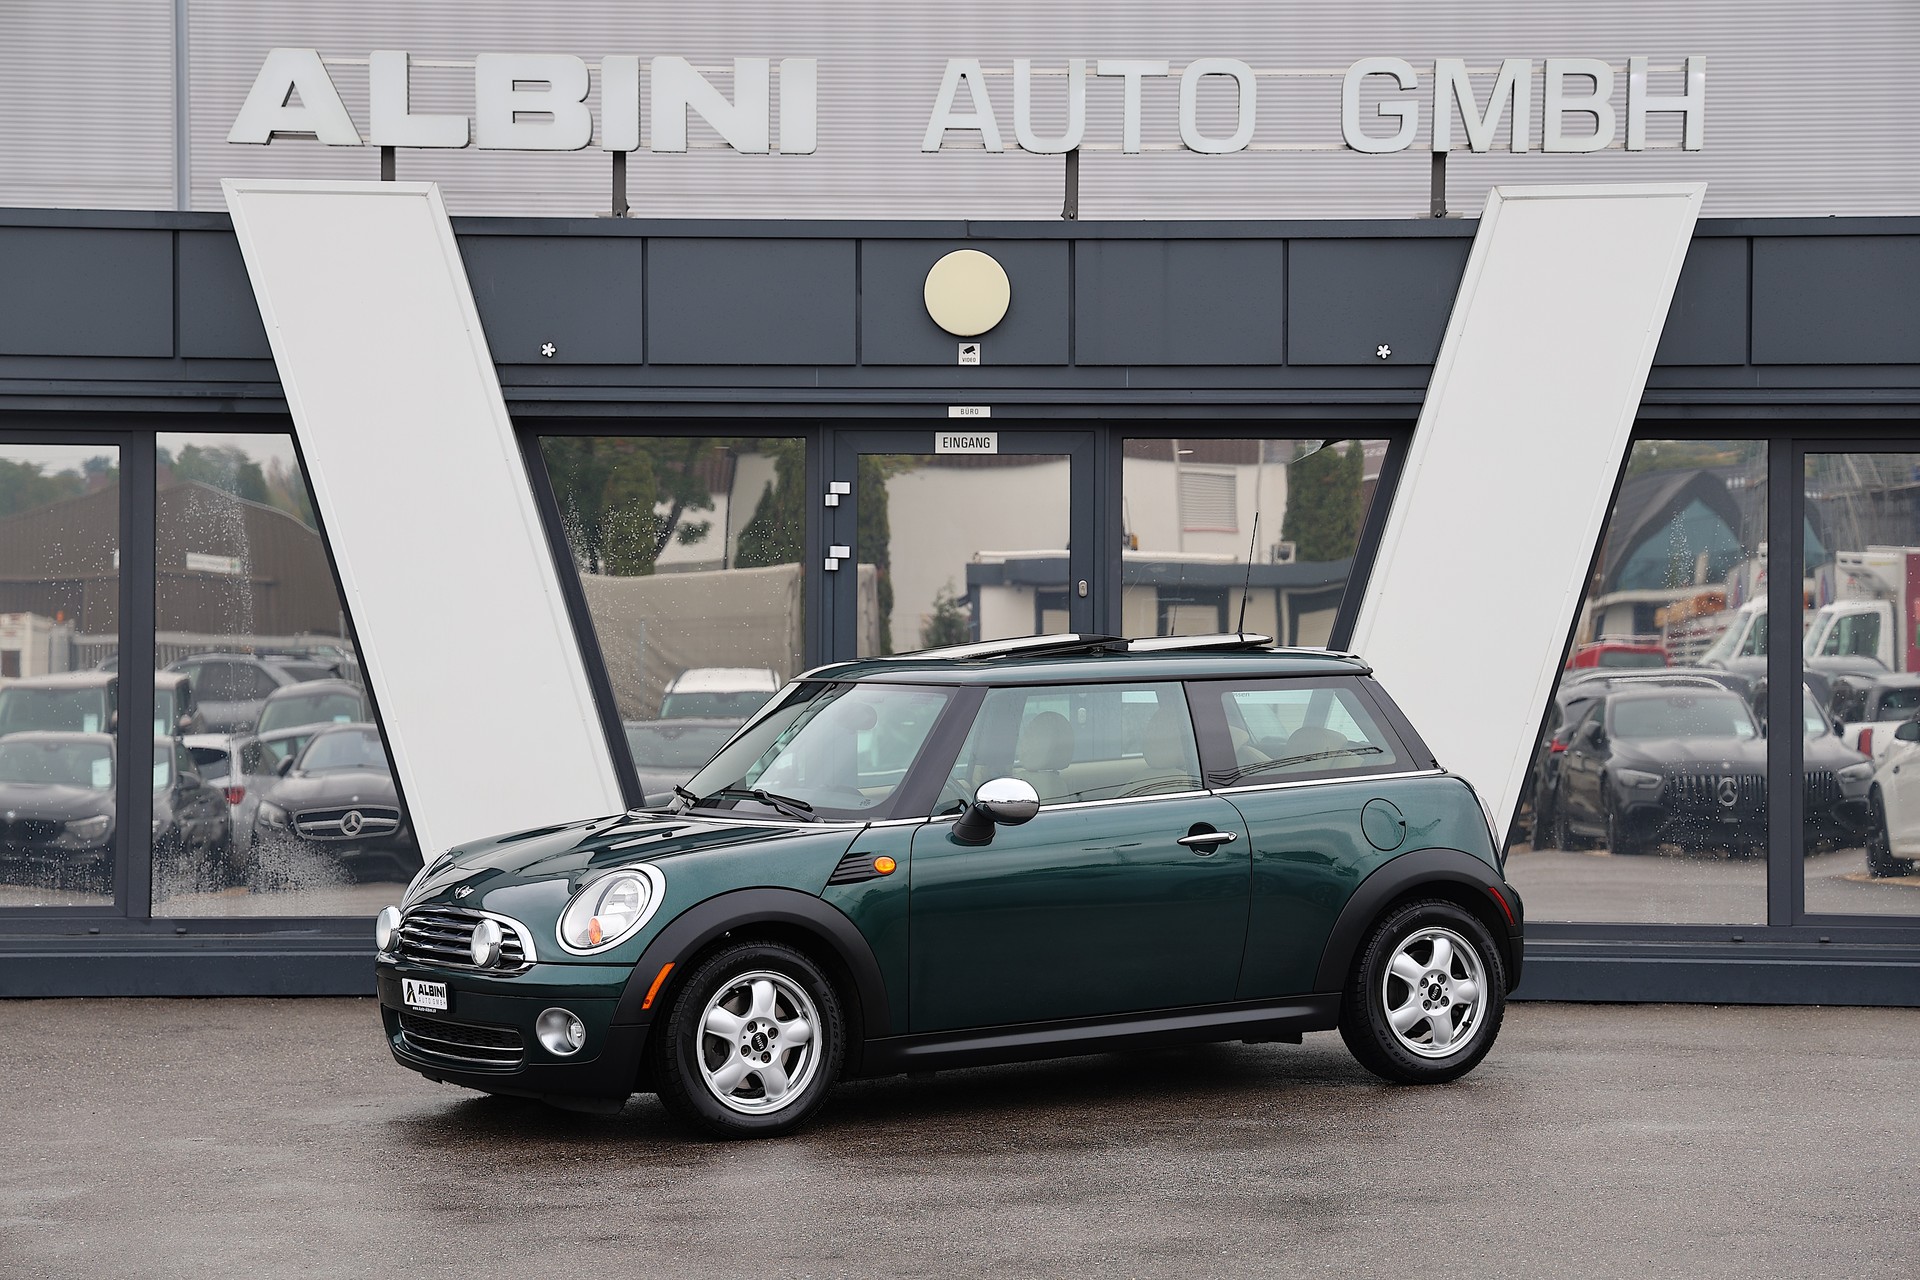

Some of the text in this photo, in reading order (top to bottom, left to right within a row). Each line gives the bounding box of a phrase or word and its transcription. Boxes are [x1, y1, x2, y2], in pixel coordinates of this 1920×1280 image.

[226, 47, 1706, 156] ALBINI AUTO GMBH
[960, 407, 979, 415] BÜRO
[943, 437, 991, 449] EINGANG
[418, 984, 445, 998] ALBINI
